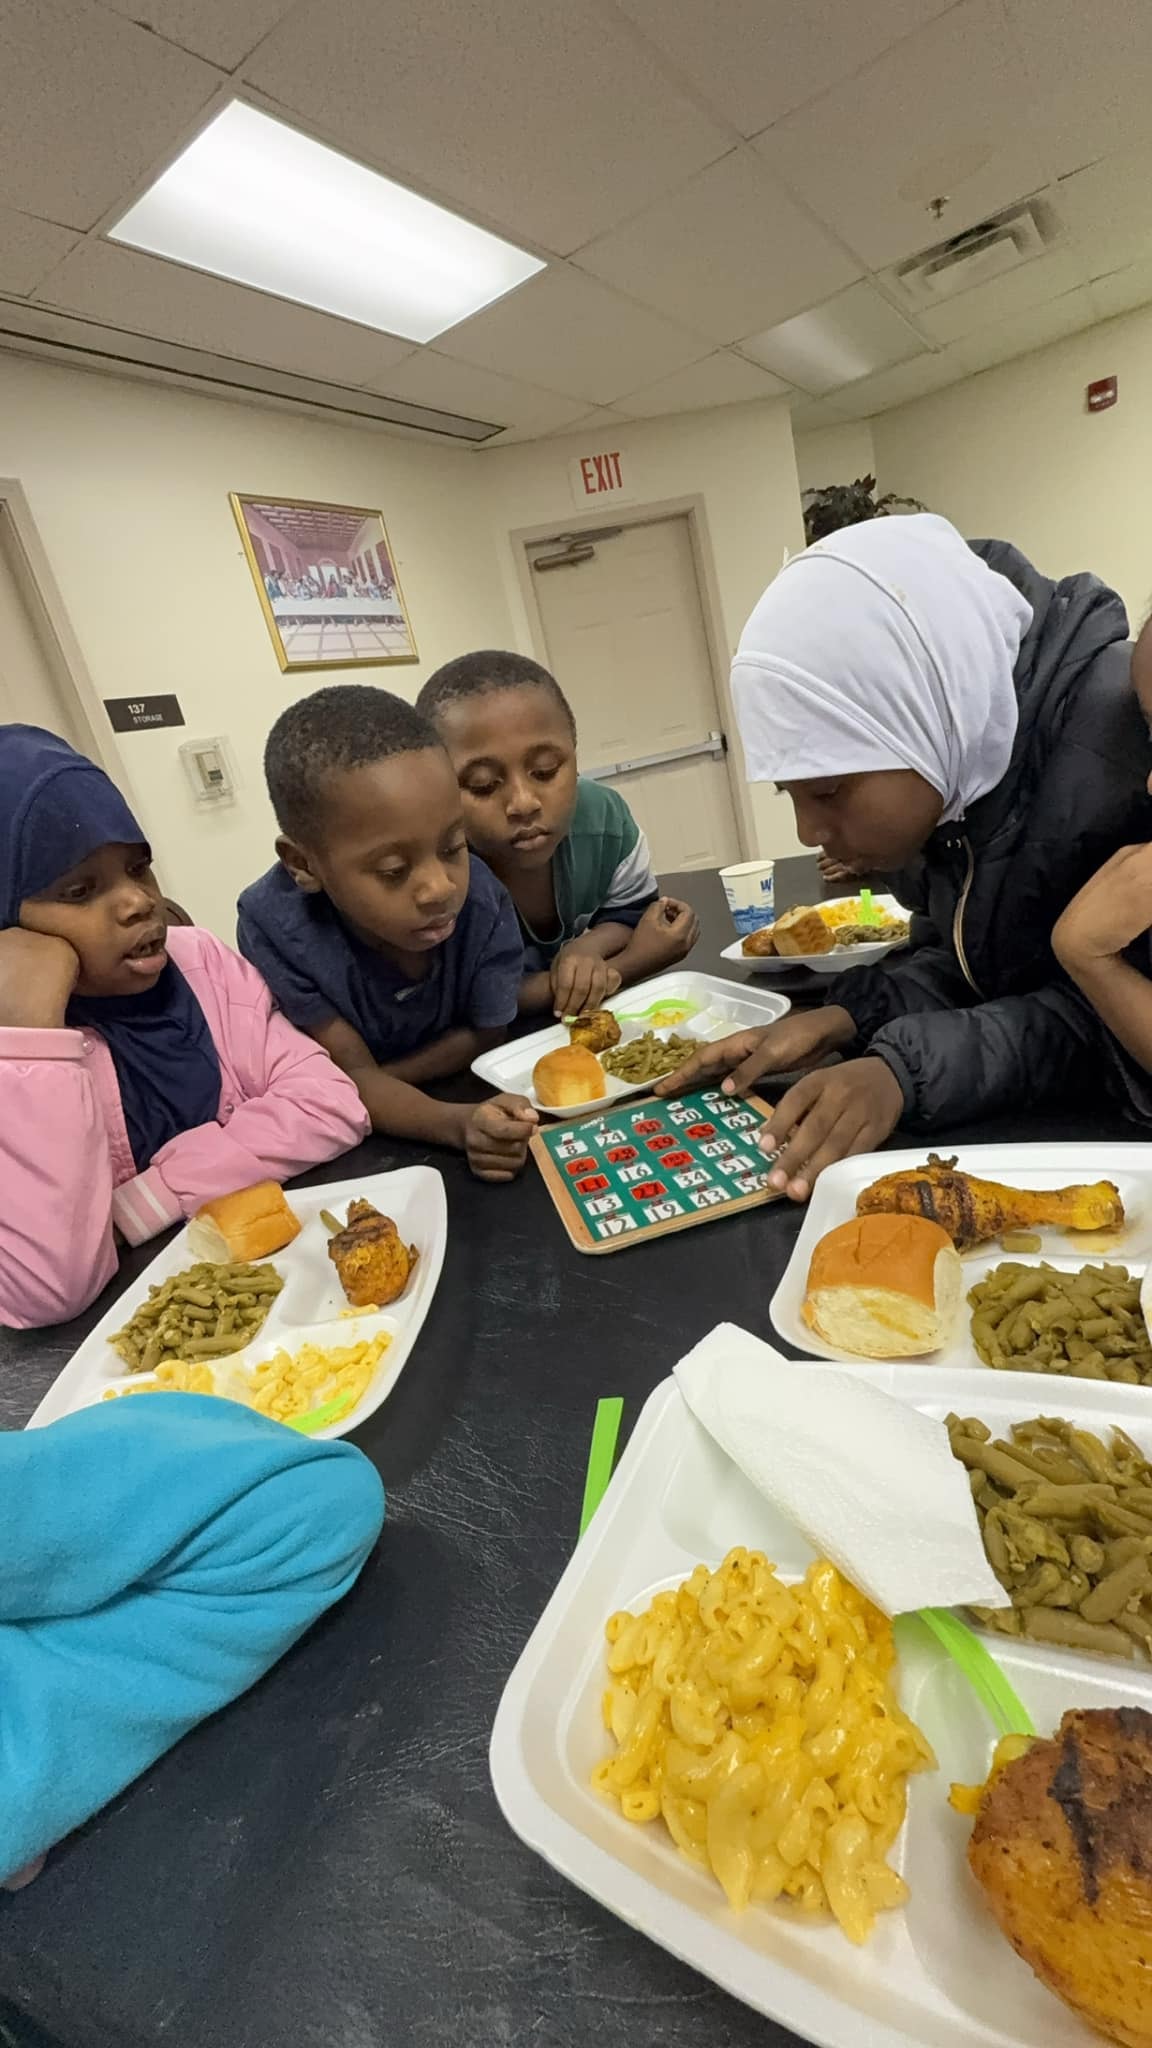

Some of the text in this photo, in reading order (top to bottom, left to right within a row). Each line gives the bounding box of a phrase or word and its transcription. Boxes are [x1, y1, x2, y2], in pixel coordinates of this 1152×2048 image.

[580, 452, 622, 494] EXIT
[128, 703, 145, 714] 137
[760, 877, 772, 891] W
[565, 1144, 578, 1156] 8
[675, 1110, 698, 1123] 50
[714, 1100, 737, 1114] 74
[651, 1136, 676, 1150] 39
[729, 1115, 751, 1129] 69
[580, 1178, 602, 1193] 11
[623, 1166, 649, 1181] 16
[706, 1141, 732, 1155] 48
[592, 1197, 617, 1213] 13
[680, 1170, 707, 1187] 34
[721, 1158, 748, 1173] 51
[603, 1174, 768, 1236] 12 19 43 56
